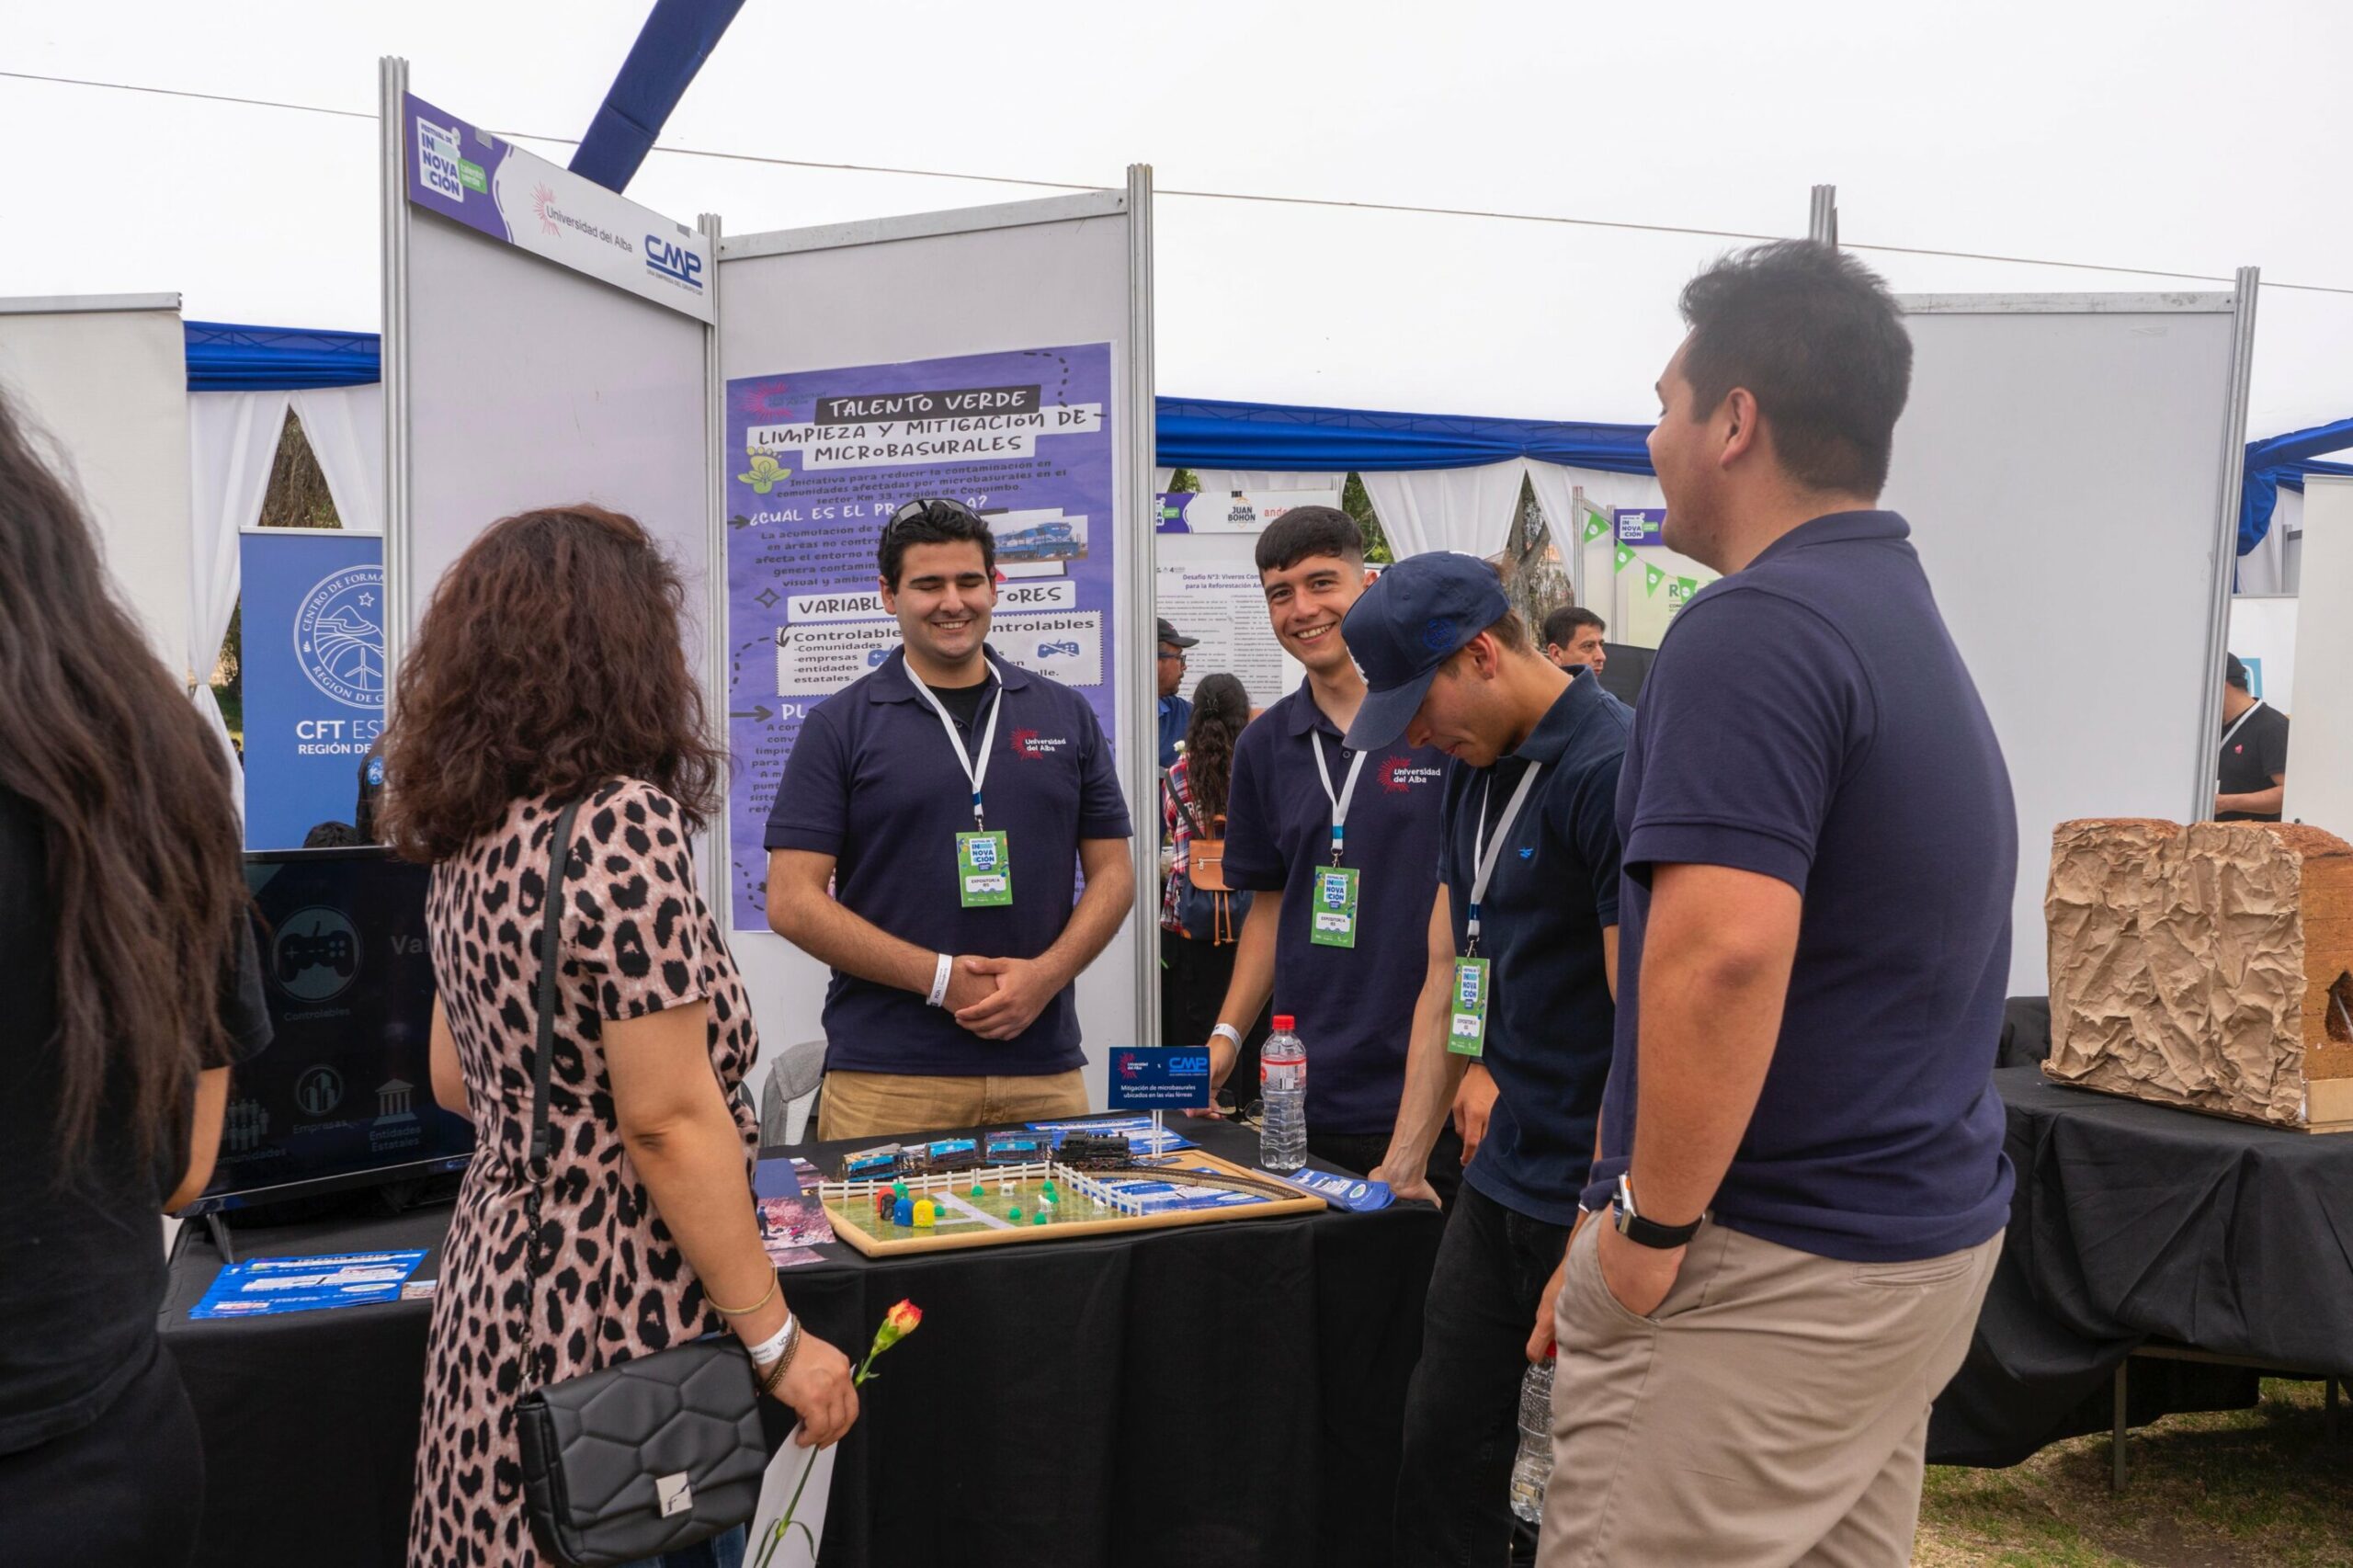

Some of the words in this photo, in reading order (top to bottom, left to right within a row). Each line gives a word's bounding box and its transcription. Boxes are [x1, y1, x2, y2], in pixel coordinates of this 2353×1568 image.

[422, 132, 435, 152] IN
[423, 150, 458, 179] NOVA
[546, 205, 597, 238] Universidad
[600, 230, 613, 244] del
[615, 234, 633, 254] Alba
[645, 233, 702, 279] CMP
[829, 392, 934, 418] TALENTO
[945, 391, 1028, 411] VERDE
[759, 426, 866, 446] LIMPIEZA
[878, 423, 894, 437] Y
[1057, 409, 1086, 426] DE
[814, 436, 1023, 461] MICROBASURALES
[777, 485, 848, 498] comunidades
[853, 481, 910, 492] afectadas
[915, 479, 936, 491] por
[939, 471, 1031, 486] microbasurales
[1037, 470, 1051, 478] en
[1055, 469, 1067, 477] el
[790, 475, 846, 487] Iniciativa
[849, 474, 878, 486] para
[881, 469, 926, 482] reducir
[930, 467, 941, 476] la
[816, 495, 854, 505] sector
[857, 494, 874, 502] Km
[899, 490, 938, 501] región
[960, 483, 1022, 496] Coquimbo.
[812, 506, 835, 520] ES
[844, 504, 866, 517] EL
[1228, 514, 1256, 522] BOHON
[1232, 506, 1253, 515] JUAN
[761, 532, 775, 540] La
[858, 525, 873, 533] de
[841, 536, 881, 546] contro
[756, 553, 795, 565] afecta
[800, 553, 811, 562] el
[814, 551, 862, 561] entorno
[774, 567, 816, 578] genera
[783, 578, 818, 588] visual
[822, 579, 830, 587] y
[834, 575, 879, 585] ambien
[1208, 582, 1252, 590] Reforestación
[302, 591, 329, 632] CENTRO
[327, 580, 344, 594] DE
[344, 574, 384, 585] FORMA
[799, 596, 884, 615] VARIABL
[794, 628, 904, 642] Controlable
[992, 619, 1095, 633] ntrolables
[794, 642, 882, 653] -Comunidades
[794, 653, 858, 664] -empresas
[794, 664, 859, 673] -entidades
[313, 665, 353, 699] REGION
[355, 693, 372, 703] DE
[794, 675, 854, 684] estatales.
[296, 720, 346, 740] CFT
[298, 741, 351, 755] REGIÓN
[354, 743, 372, 755] DE
[756, 747, 791, 756] limpie
[752, 759, 779, 768] para
[1393, 767, 1441, 777] Universidad
[283, 1006, 352, 1022] Controlables
[1169, 1057, 1208, 1071] CMP
[291, 1118, 348, 1135] Empresas
[369, 1125, 423, 1142] Entidades
[371, 1137, 420, 1153] Estatales
[217, 1145, 288, 1165] omunidades
